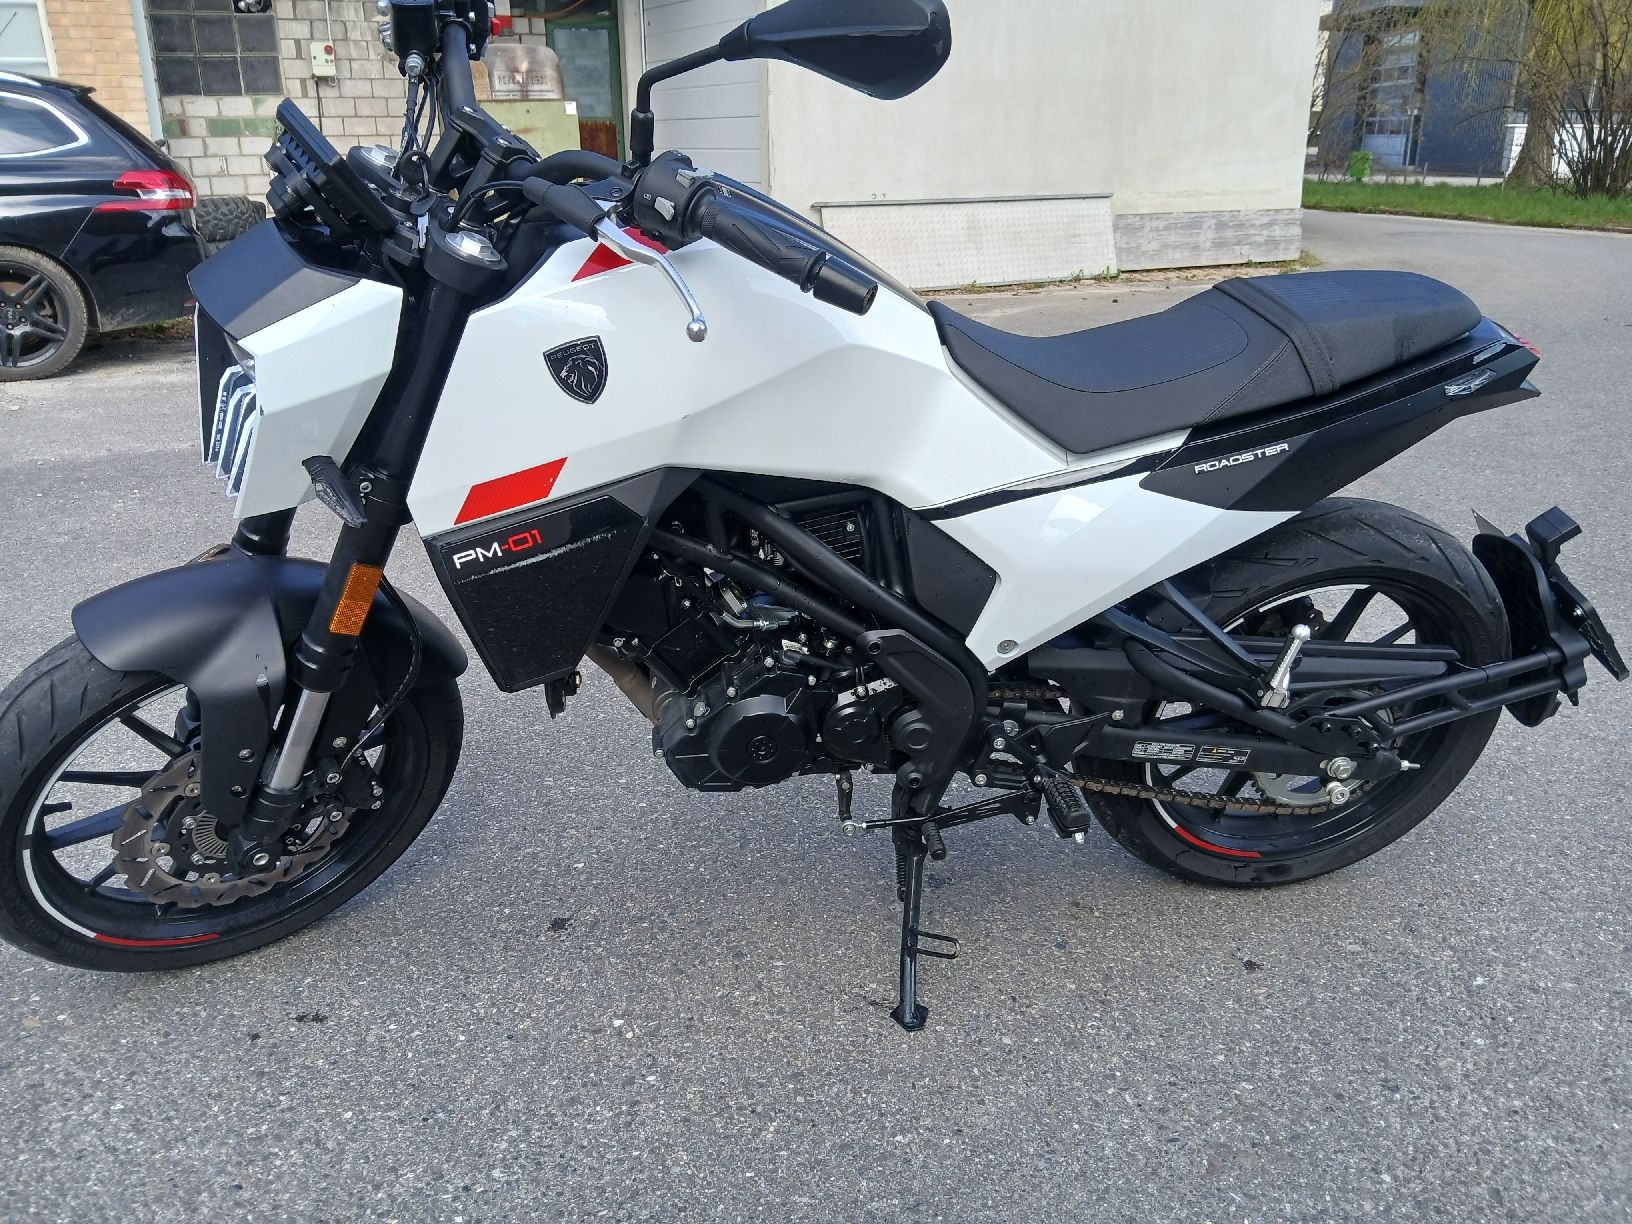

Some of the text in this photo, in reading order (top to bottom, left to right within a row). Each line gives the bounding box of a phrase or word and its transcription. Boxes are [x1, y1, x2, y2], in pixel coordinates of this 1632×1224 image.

[550, 342, 596, 360] PEUGEOT
[1194, 442, 1290, 475] ROADSTER
[452, 529, 544, 570] PM-01
